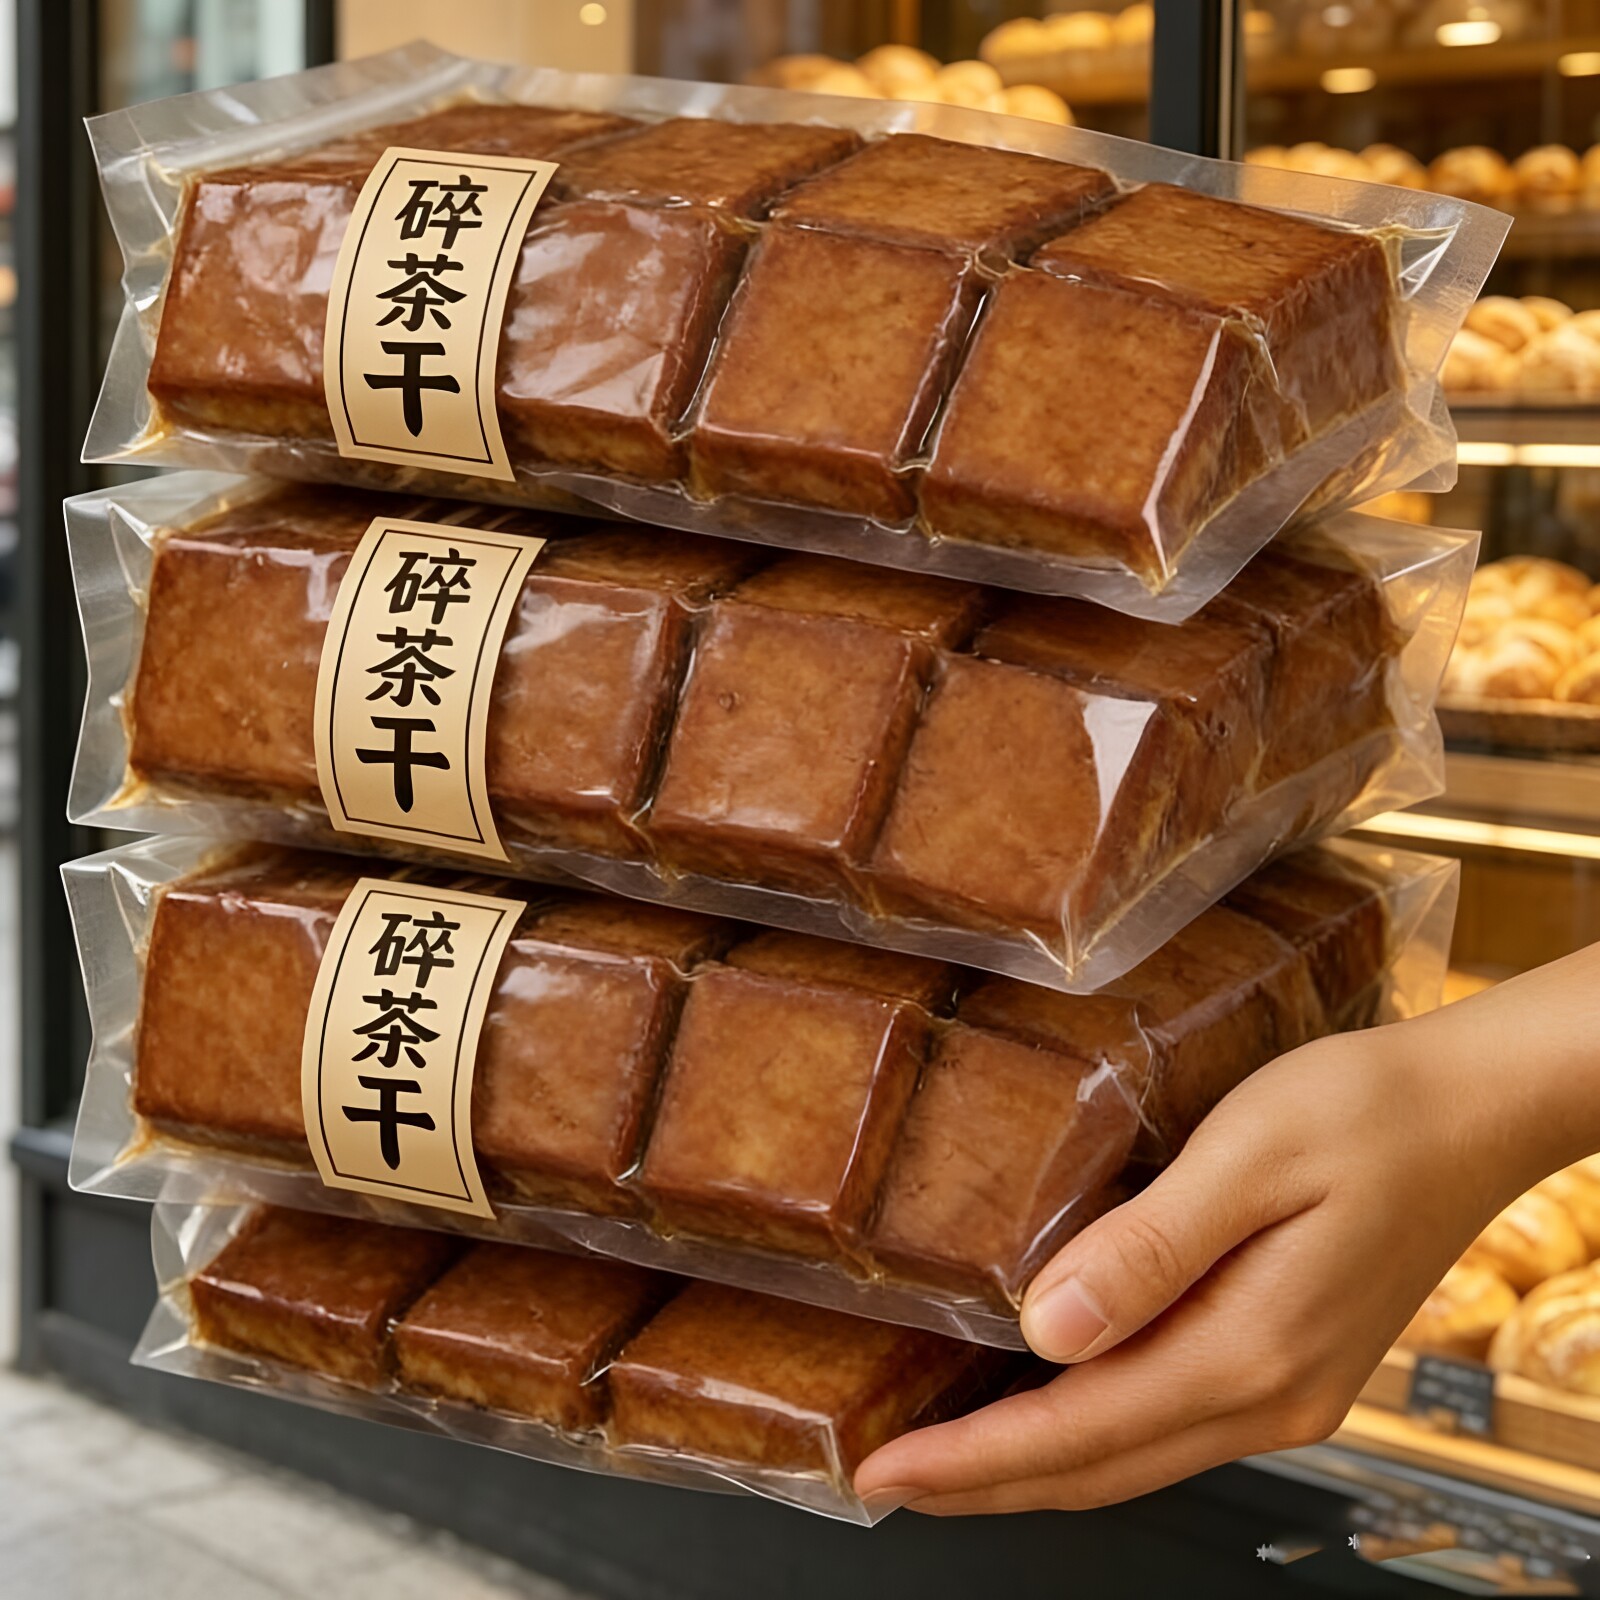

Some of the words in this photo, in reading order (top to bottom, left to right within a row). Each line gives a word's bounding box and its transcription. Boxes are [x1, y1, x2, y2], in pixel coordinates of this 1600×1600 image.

[364, 174, 489, 438] 碎茶干
[355, 547, 477, 814] 碎茶干
[341, 911, 461, 1171] 碎茶干
